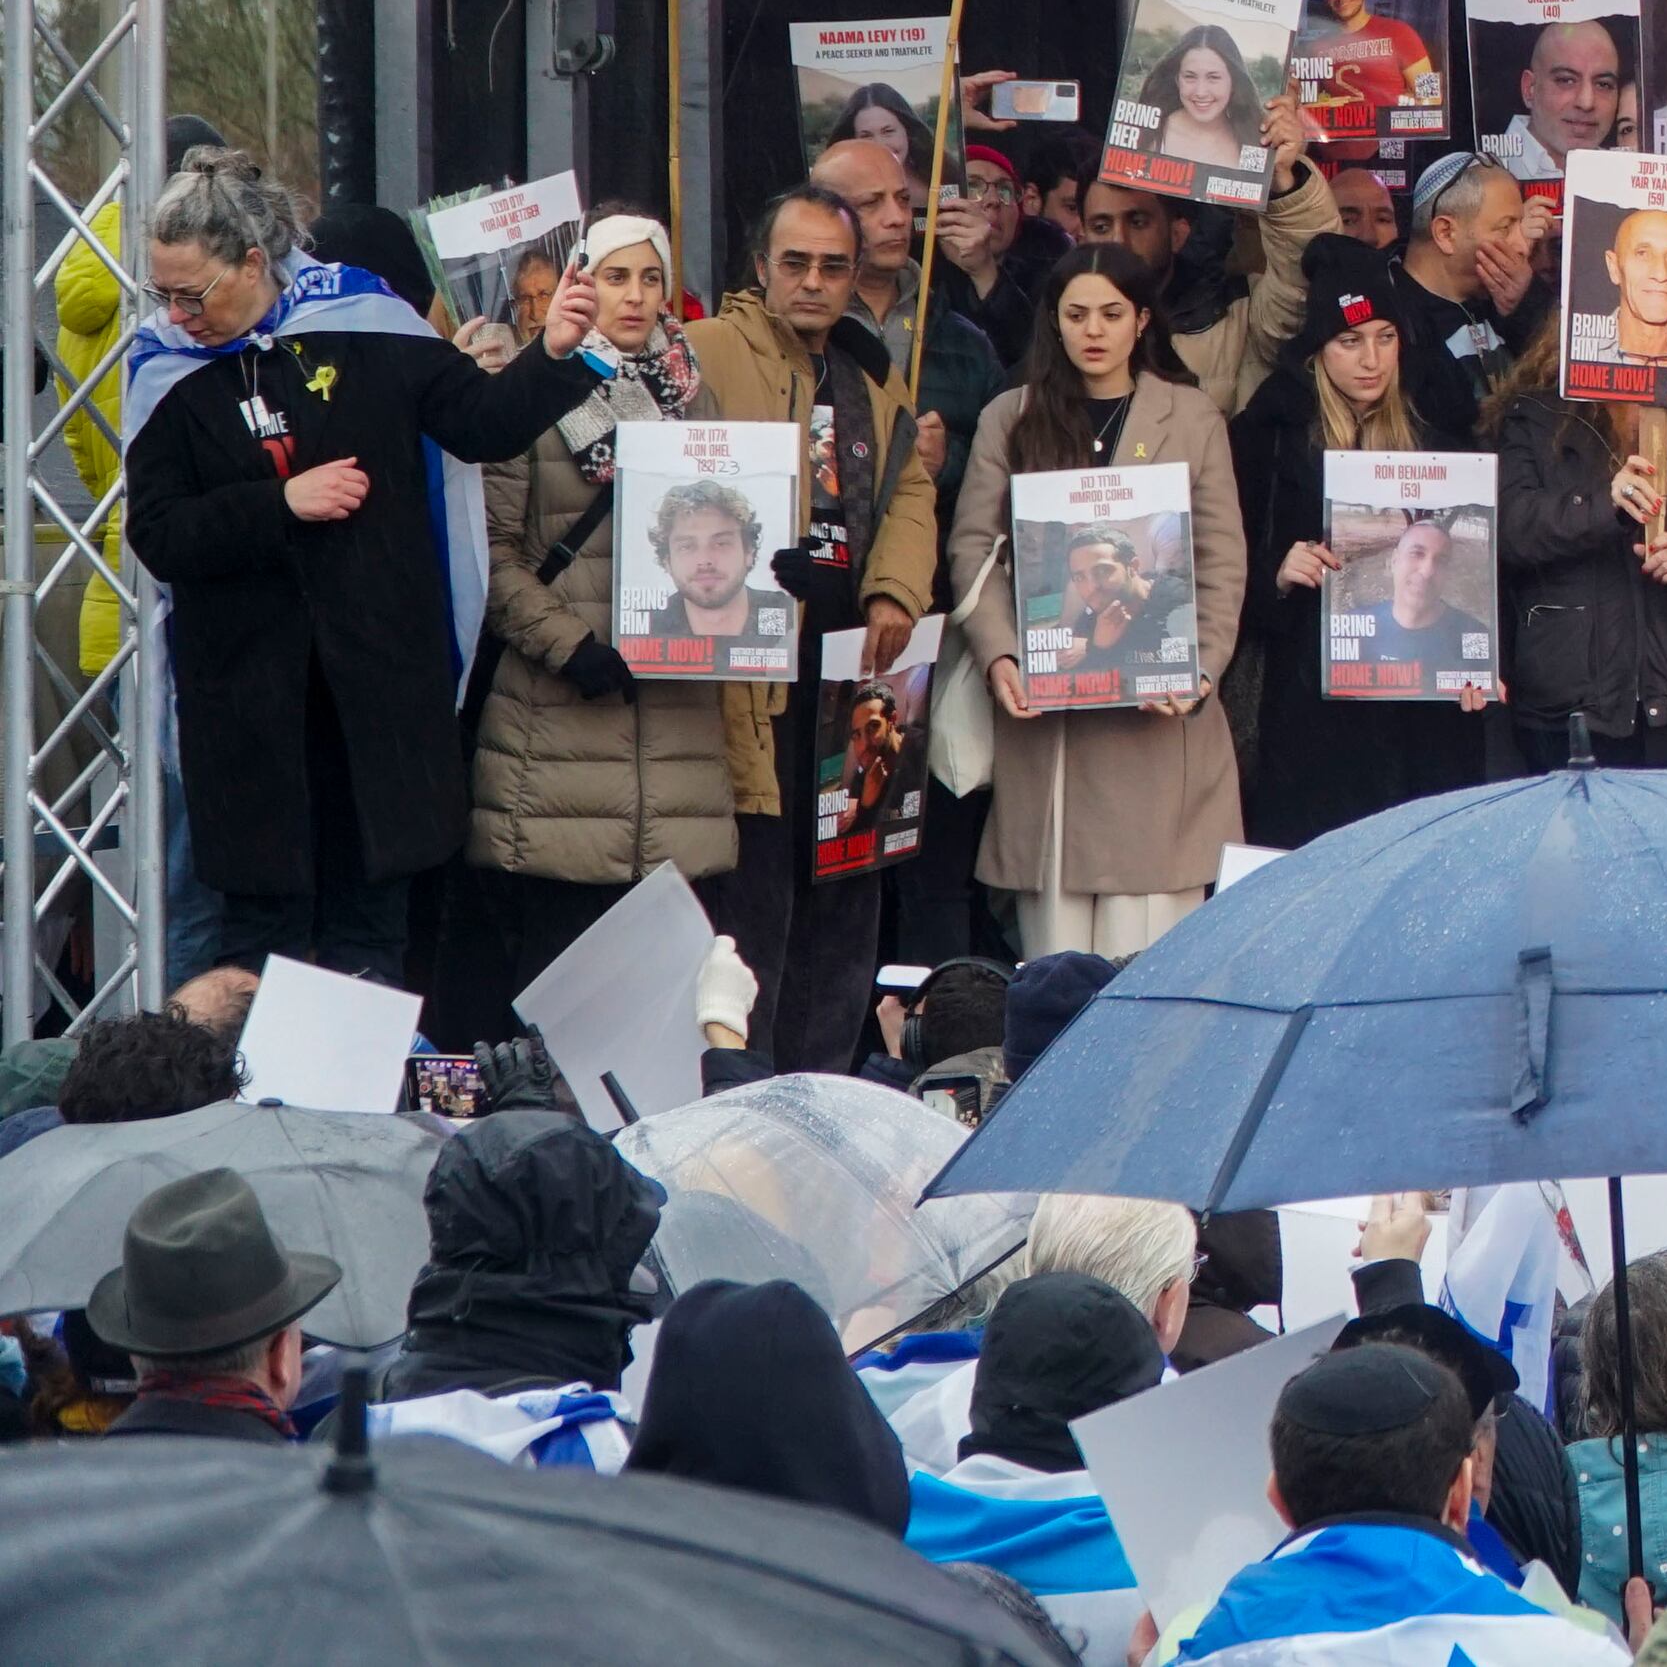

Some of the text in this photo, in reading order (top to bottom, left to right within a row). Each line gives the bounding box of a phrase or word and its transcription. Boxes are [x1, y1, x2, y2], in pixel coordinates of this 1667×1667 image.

[1543, 5, 1560, 19] (40)
[819, 27, 925, 45] NAAMA LEVY (19)
[815, 45, 933, 59] A PEACE SEEKER AND TRIATHLETE
[1114, 100, 1161, 129] BRING
[1336, 106, 1376, 129] NOW!
[1110, 124, 1140, 149] HER
[1481, 134, 1523, 158] BRING
[1106, 148, 1195, 184] HOME NOW!
[1631, 176, 1650, 190] YAIR
[1647, 192, 1665, 206] (59)
[480, 204, 541, 234] YORAM METZGER
[1572, 312, 1616, 339] BRING
[1571, 337, 1599, 361] HIM
[1569, 364, 1608, 389] HOME
[1613, 366, 1656, 394] NOW!
[687, 428, 728, 443] אלון אהל
[683, 443, 731, 457] ALON OHEL
[1375, 464, 1447, 481] RON BENJAMIN
[1069, 488, 1133, 504] NIMROD COHEN
[1400, 483, 1421, 499] (53)
[621, 586, 668, 611] BRING
[620, 610, 650, 635] HIM
[1330, 614, 1376, 637] BRING
[621, 637, 714, 663] HOME NOW!
[1026, 627, 1073, 652] BRING
[1330, 637, 1360, 661] HIM
[730, 656, 788, 668] FAMILIES FORUM
[1027, 650, 1058, 674] HIM
[1330, 663, 1373, 686] HOME
[1377, 661, 1423, 685] NOW!
[1027, 670, 1120, 697] HOME NOW!
[818, 788, 849, 817] BRING
[818, 815, 838, 841] HIM
[817, 838, 844, 866] HOME
[847, 829, 876, 860] NOW!
